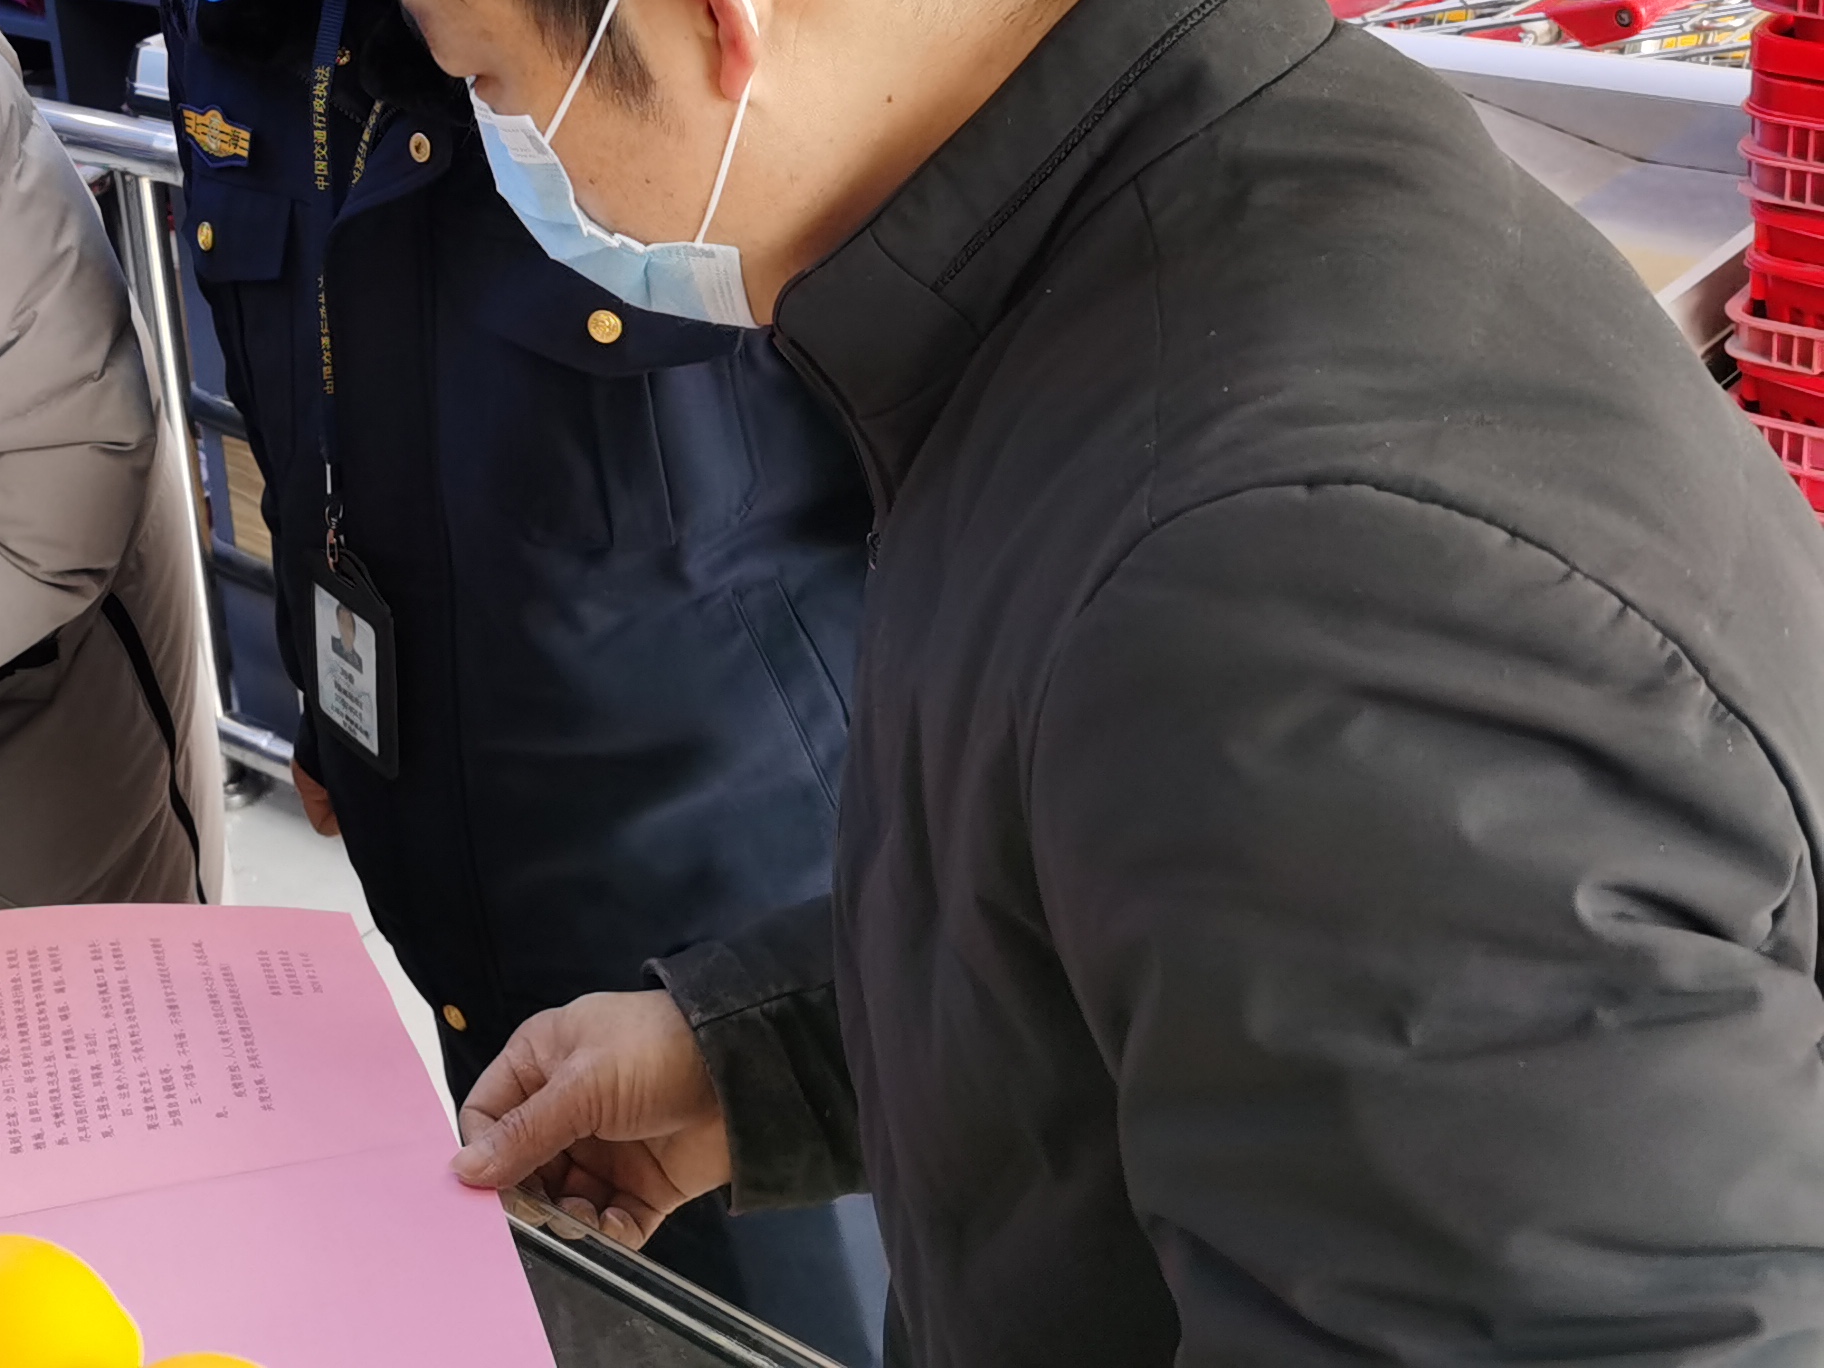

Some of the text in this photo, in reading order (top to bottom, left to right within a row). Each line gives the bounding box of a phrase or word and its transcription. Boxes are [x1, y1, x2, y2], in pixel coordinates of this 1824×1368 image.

[312, 65, 332, 191] 中国交通行政执法
